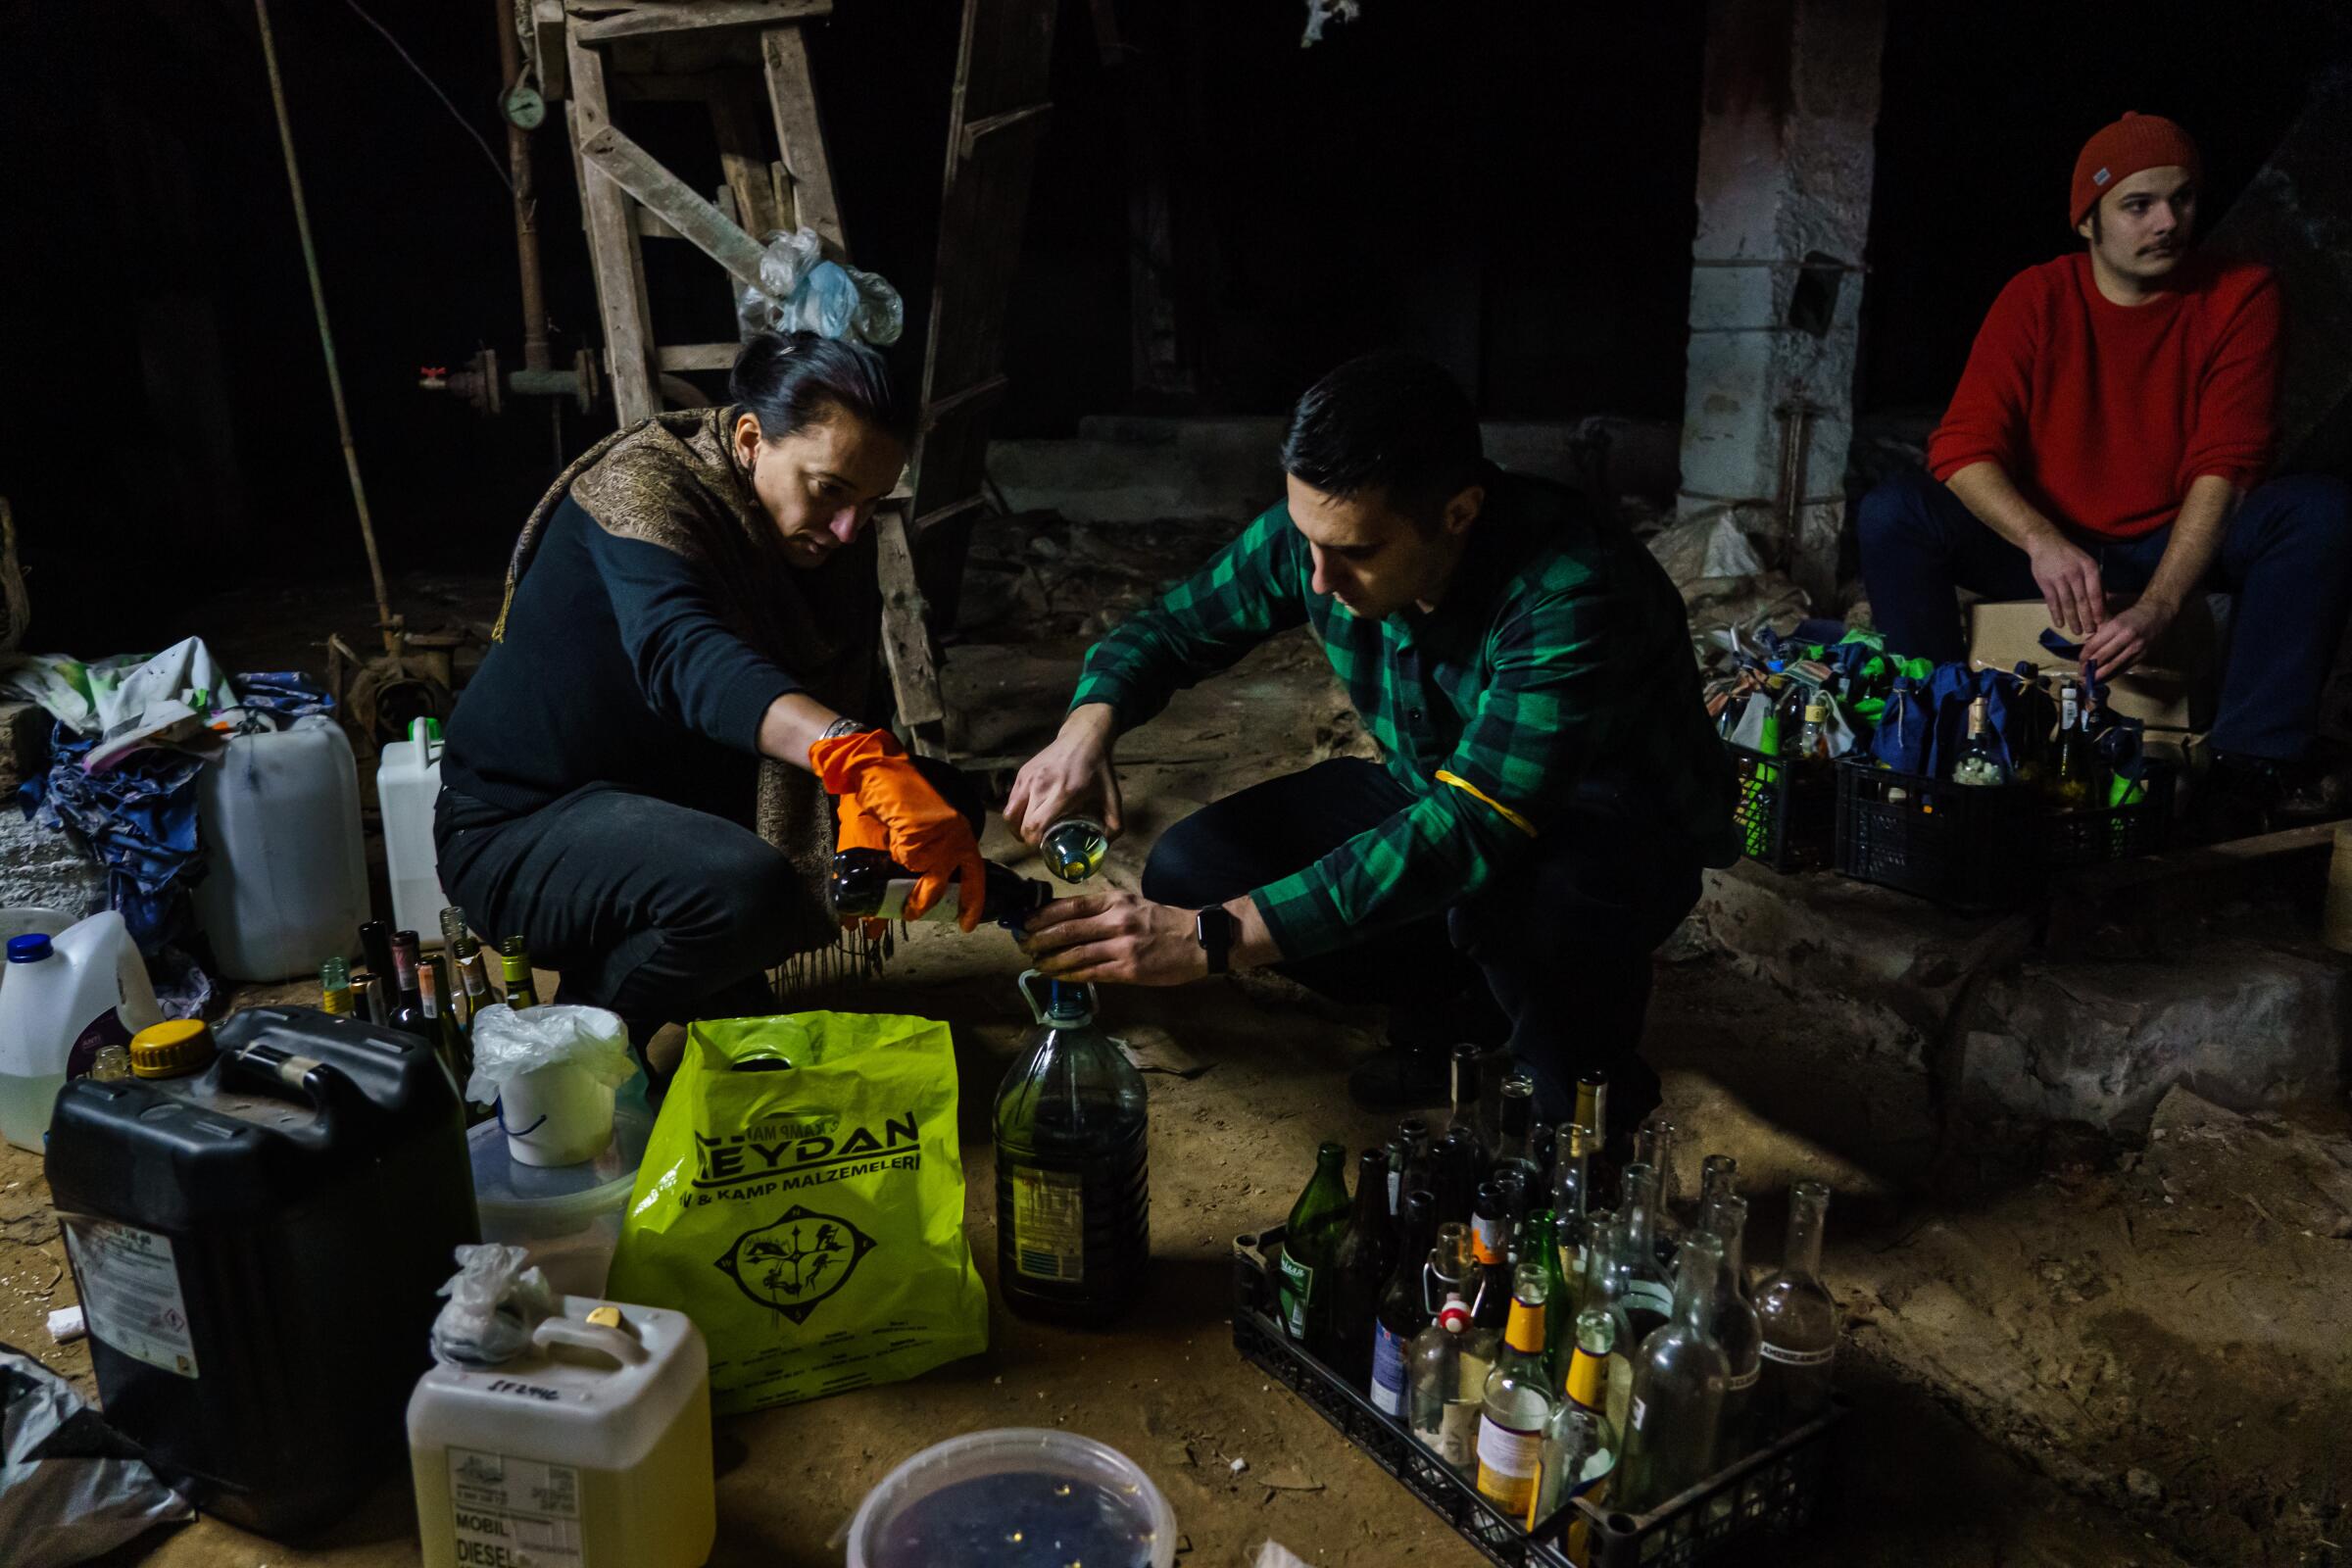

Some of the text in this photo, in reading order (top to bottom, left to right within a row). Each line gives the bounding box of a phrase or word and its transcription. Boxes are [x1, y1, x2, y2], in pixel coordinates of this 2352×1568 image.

[697, 1193, 712, 1206] &
[717, 1181, 778, 1200] KAMP
[456, 1514, 511, 1537] MOBIL
